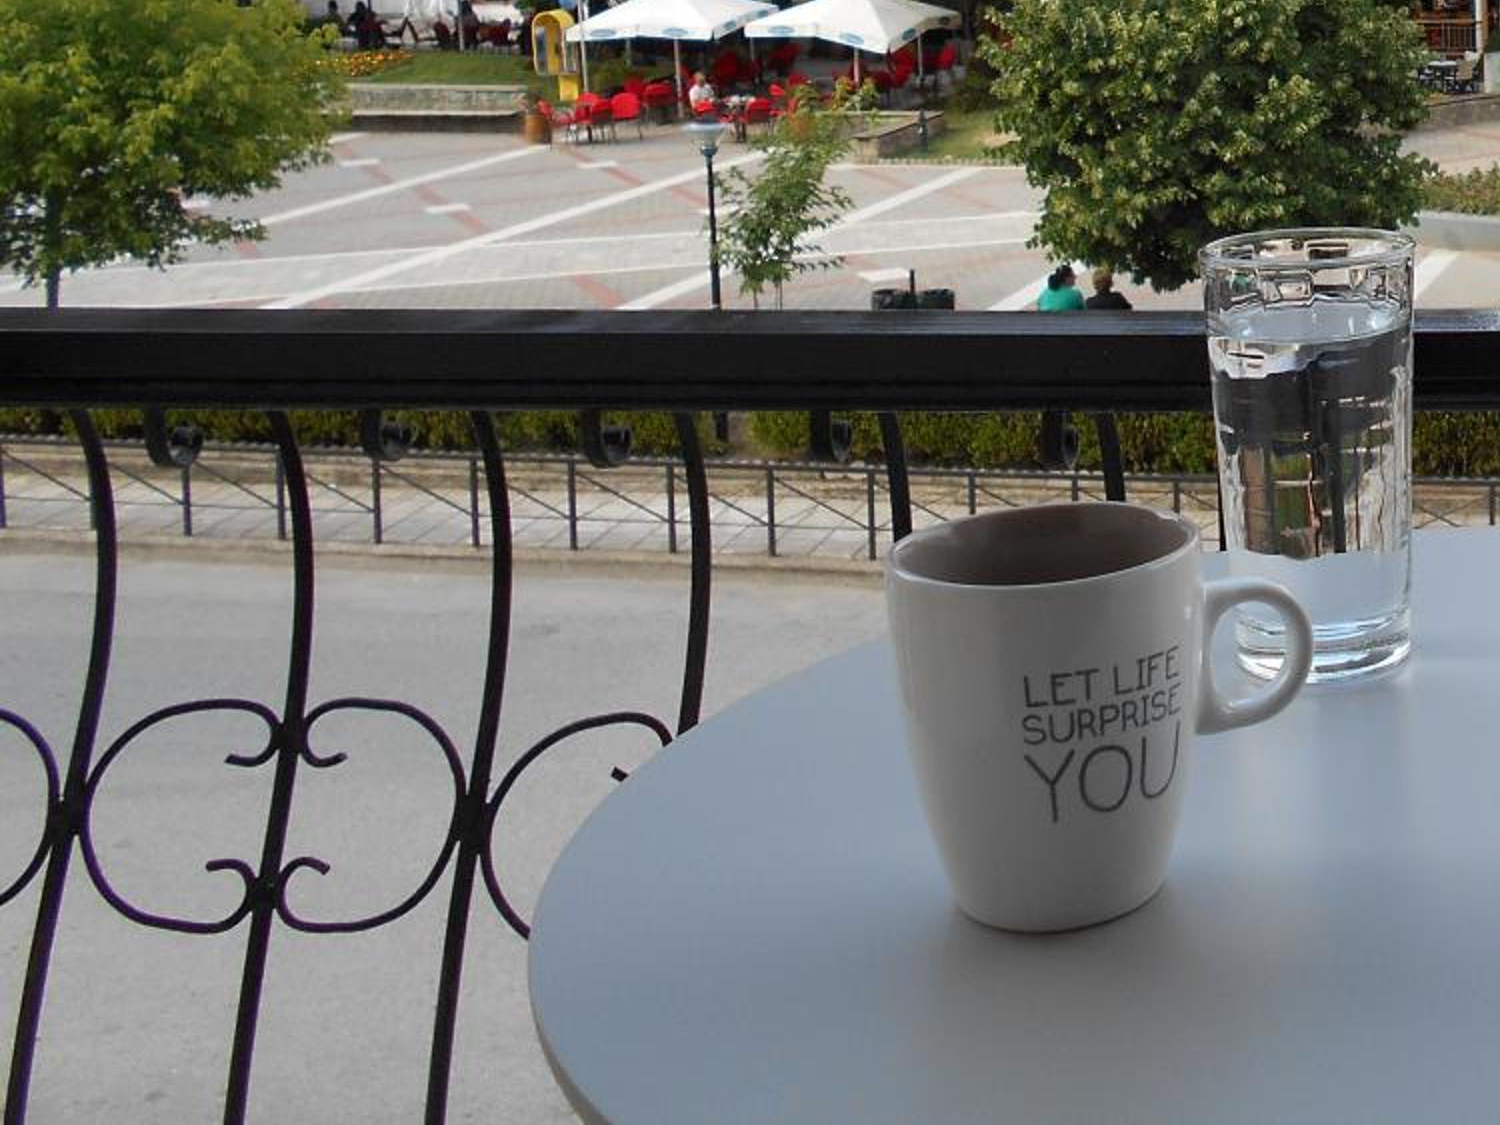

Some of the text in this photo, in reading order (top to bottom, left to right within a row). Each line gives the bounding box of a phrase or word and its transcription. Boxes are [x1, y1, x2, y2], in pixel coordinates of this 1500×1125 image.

[1023, 646, 1180, 708] LET LIFE
[1021, 683, 1182, 745] SURPRISE
[1023, 720, 1181, 823] YOU
